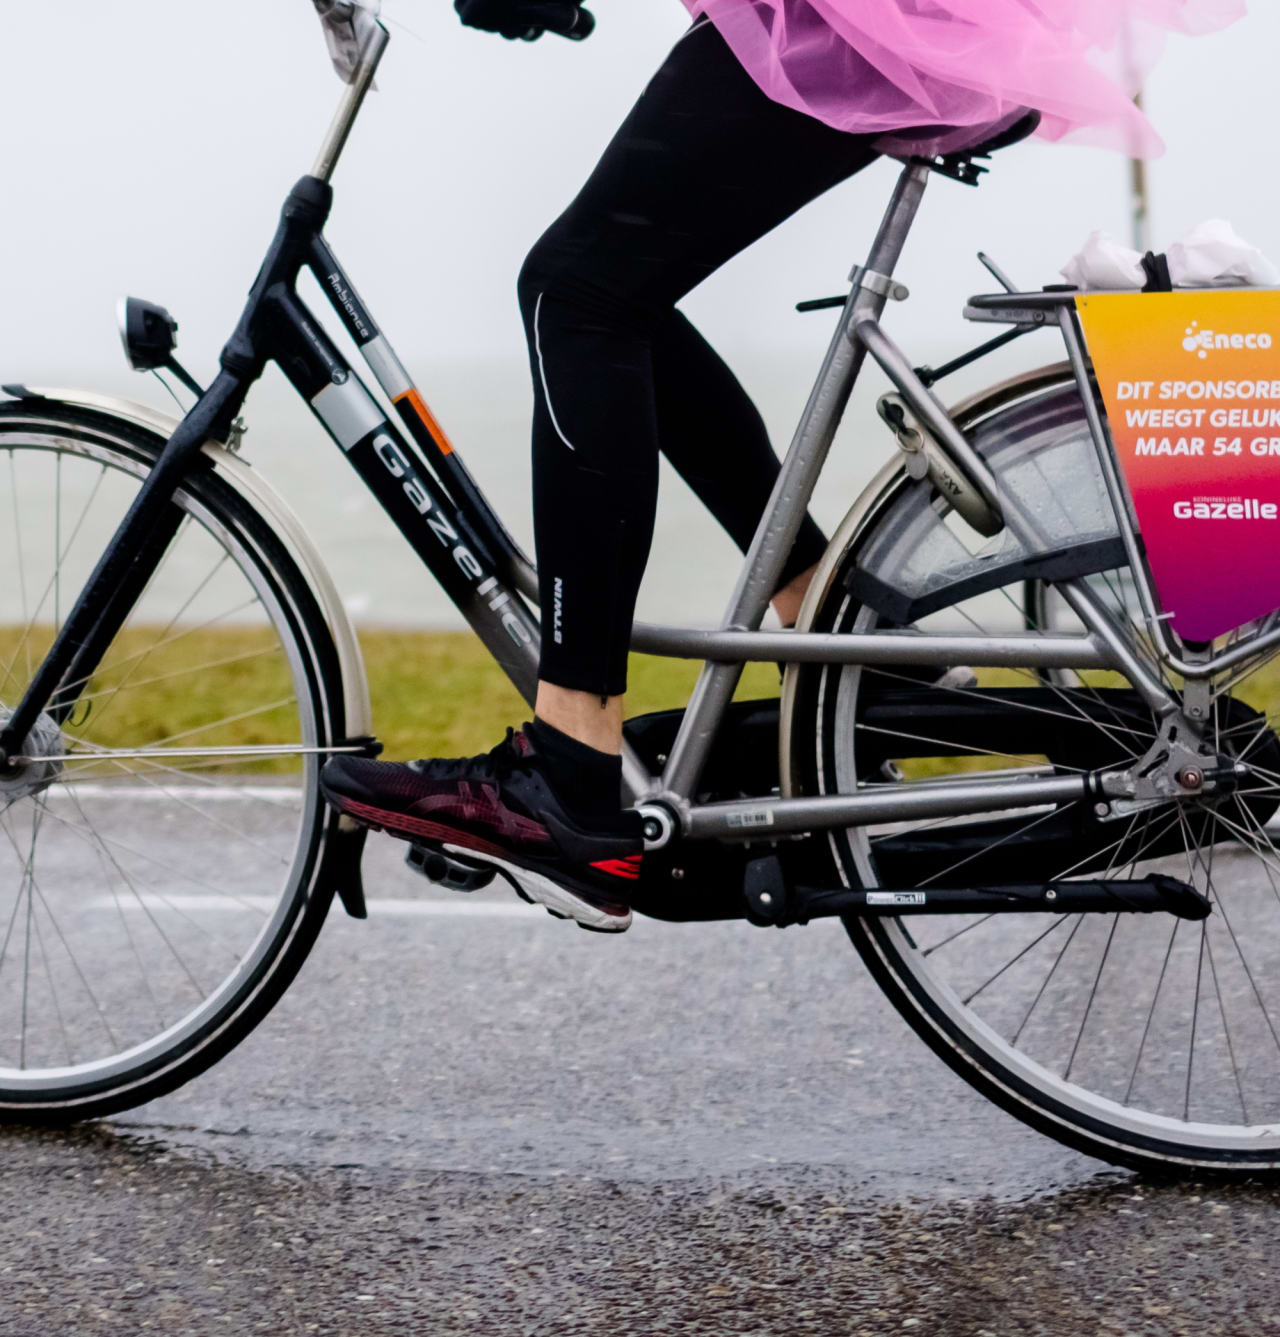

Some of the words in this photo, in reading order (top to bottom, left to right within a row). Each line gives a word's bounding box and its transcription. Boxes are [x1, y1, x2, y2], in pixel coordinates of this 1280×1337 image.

[327, 272, 369, 338] Ambiance
[1199, 330, 1272, 350] Eneco
[1116, 381, 1154, 400] DIT
[1124, 409, 1206, 428] WEEGT
[1135, 437, 1205, 456] MAAR
[1212, 437, 1242, 456] 54
[1173, 498, 1278, 519] Gazelle
[372, 433, 532, 648] Gazelle
